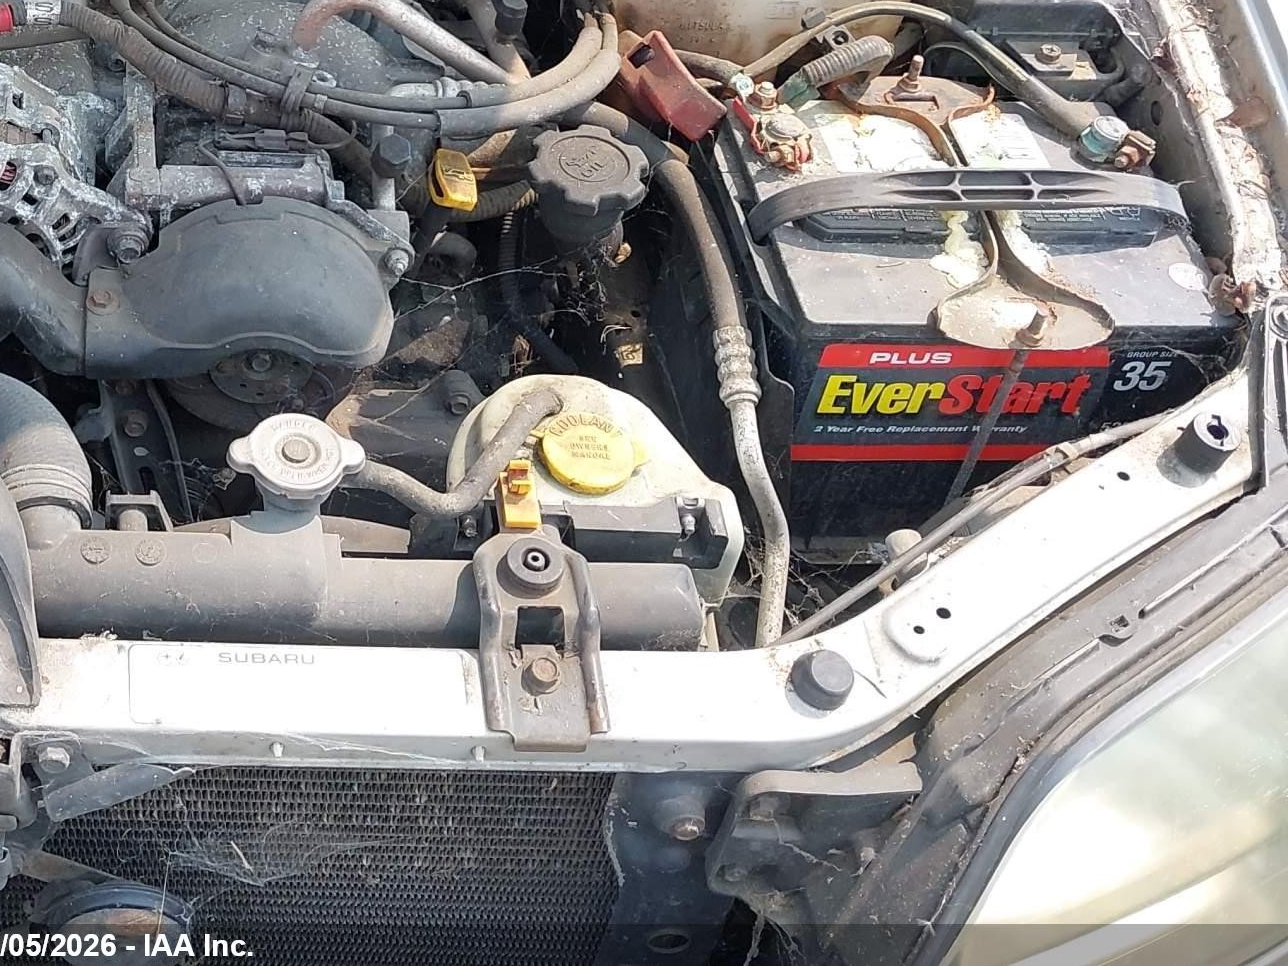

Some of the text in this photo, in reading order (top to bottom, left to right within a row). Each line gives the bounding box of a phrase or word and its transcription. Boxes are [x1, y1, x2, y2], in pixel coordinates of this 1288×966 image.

[869, 352, 952, 365] PLUS
[1112, 361, 1172, 392] 35
[816, 374, 1092, 415] EverStart
[813, 425, 824, 433] 2
[827, 425, 853, 433] Year
[855, 425, 884, 433] Free
[886, 425, 968, 434] Replacement
[218, 652, 315, 665] SUBARU
